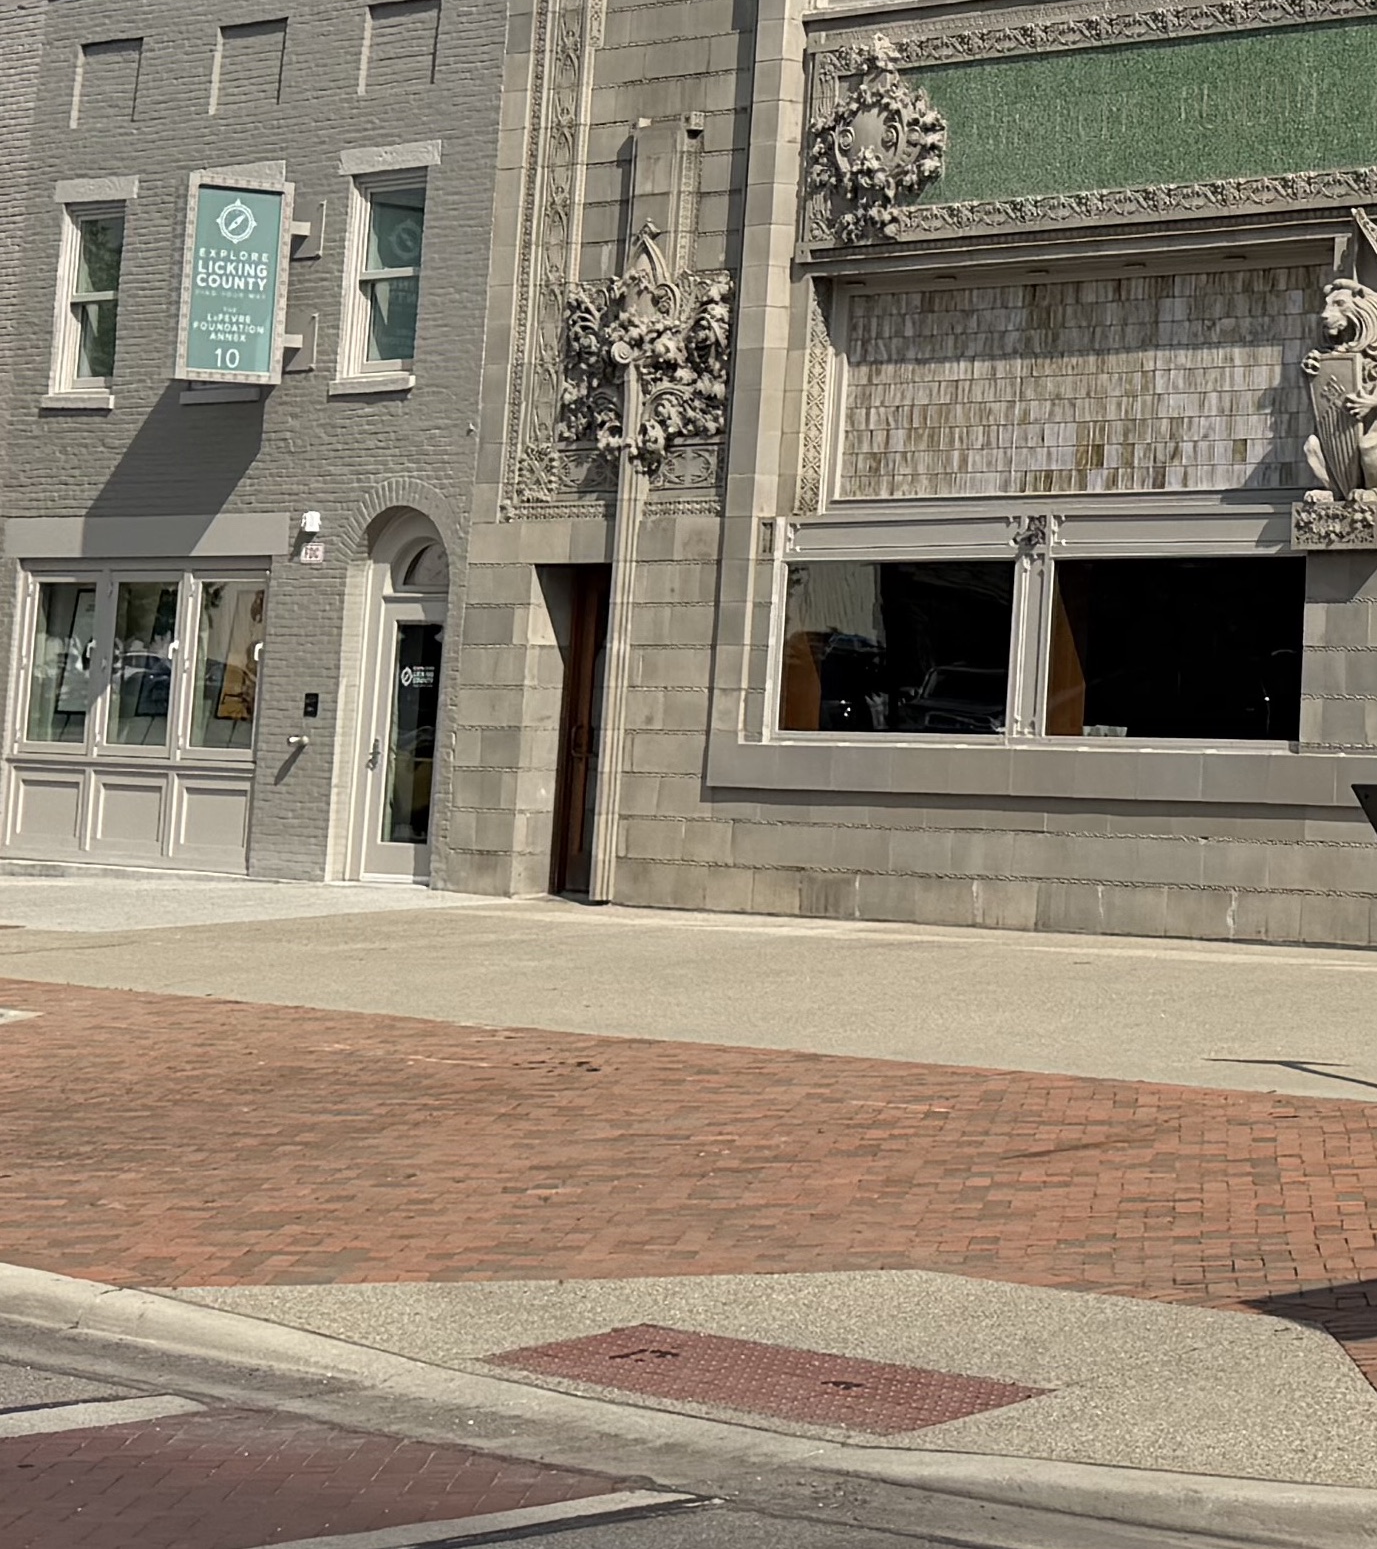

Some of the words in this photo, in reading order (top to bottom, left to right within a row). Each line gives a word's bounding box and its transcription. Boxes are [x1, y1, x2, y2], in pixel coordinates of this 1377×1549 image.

[199, 247, 269, 262] EXPLORE
[198, 259, 268, 277] LICKING
[196, 273, 267, 291] COUNTY
[193, 321, 265, 334] FOUNDATION
[209, 332, 246, 342] ANNEX
[215, 347, 240, 368] 10
